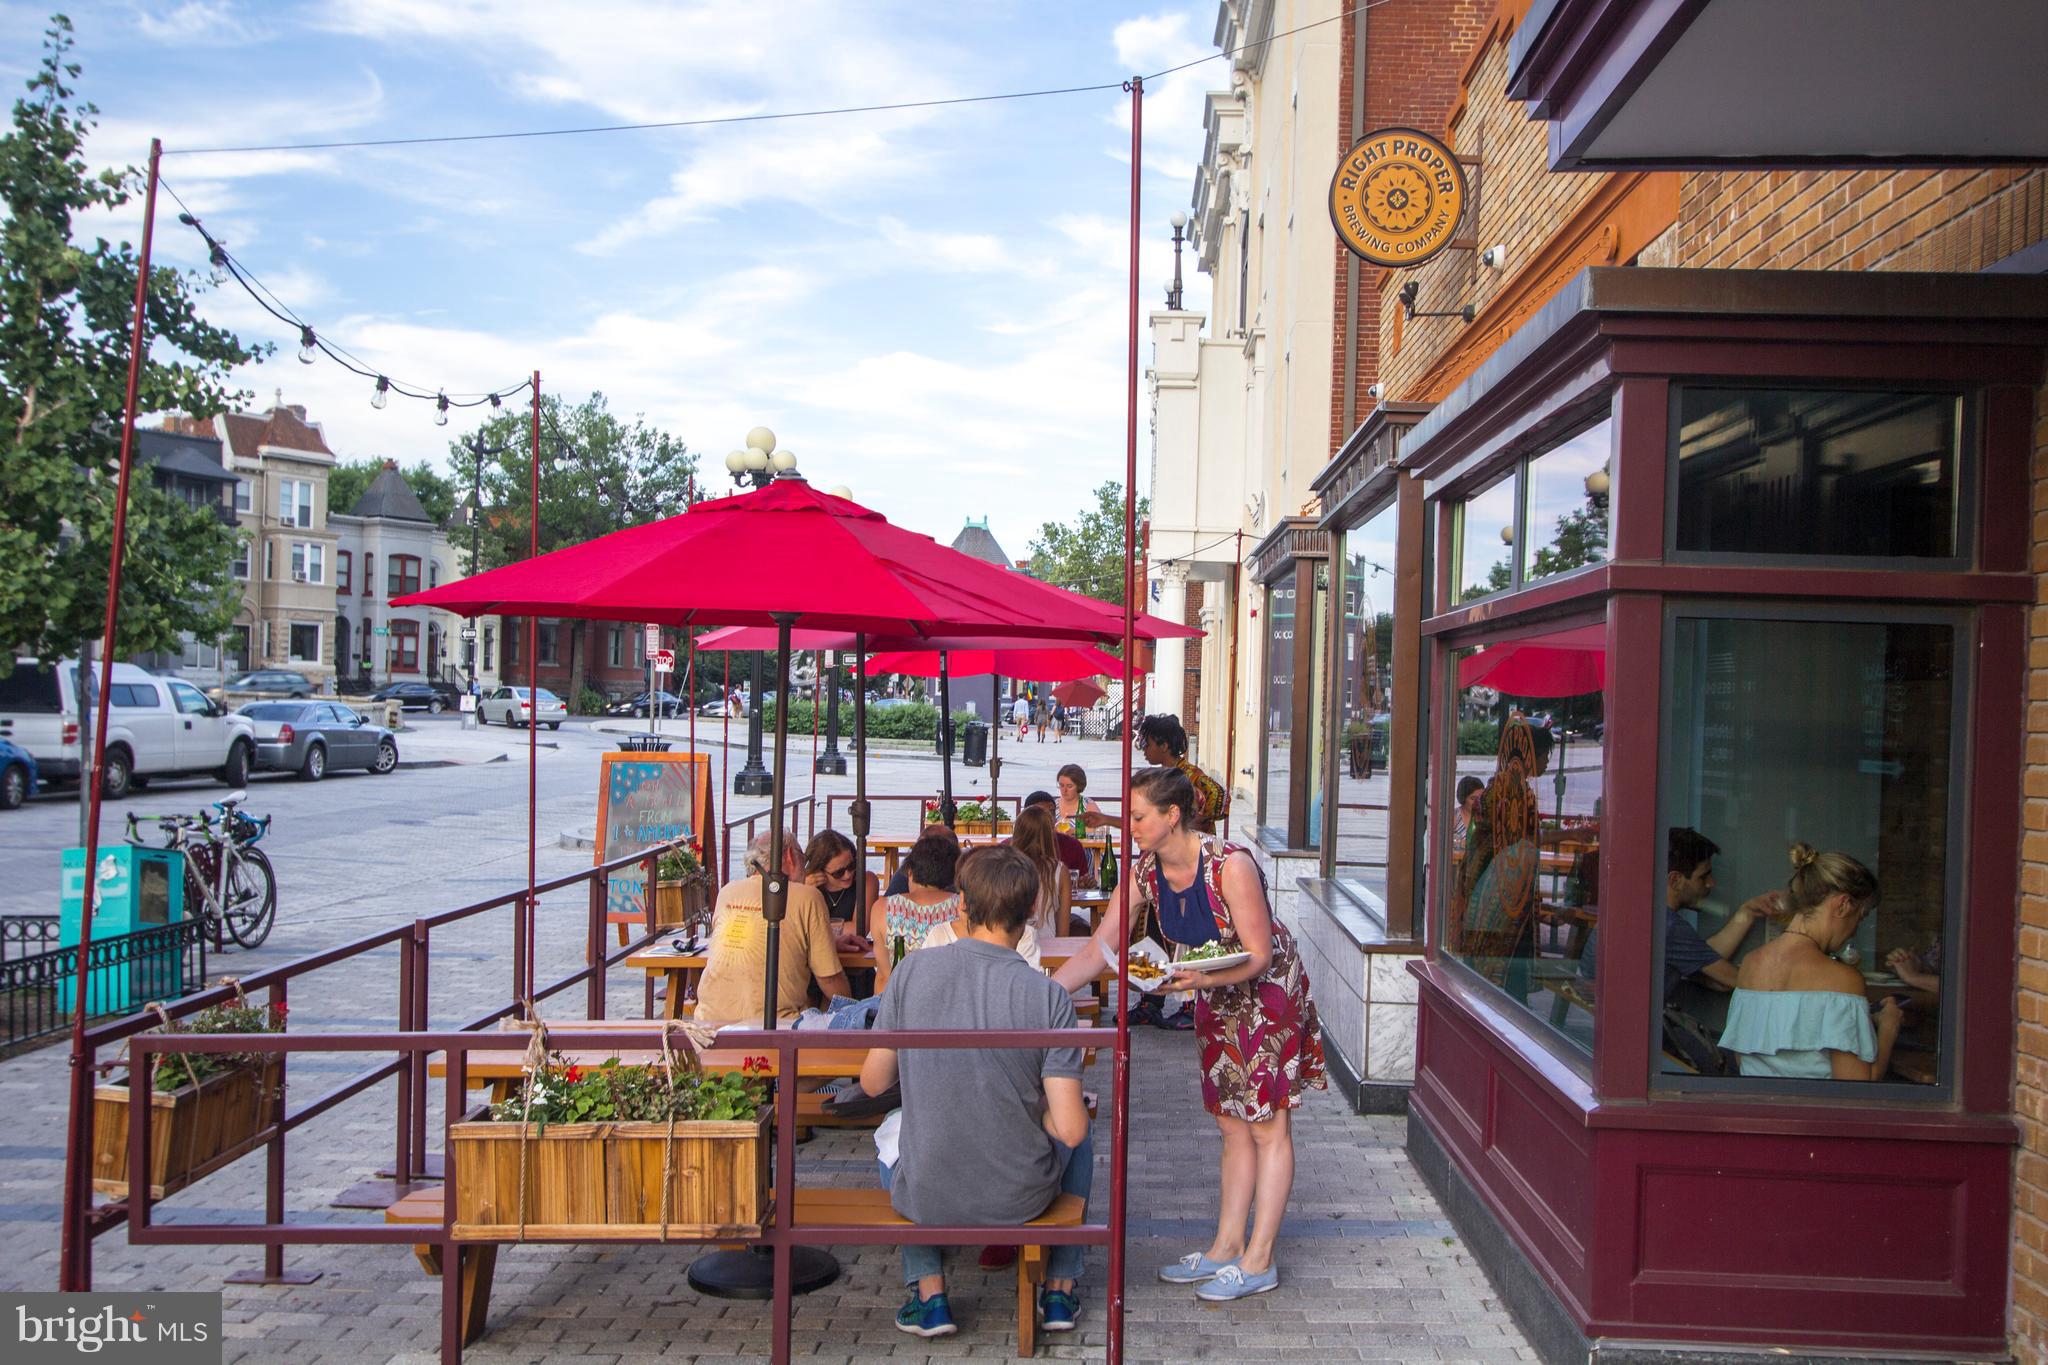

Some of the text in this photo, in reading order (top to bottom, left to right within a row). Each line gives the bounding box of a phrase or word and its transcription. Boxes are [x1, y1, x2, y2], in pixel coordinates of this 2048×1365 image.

[1341, 140, 1455, 195] RIGHT PROPER
[1343, 204, 1451, 254] BREWING COMPANY
